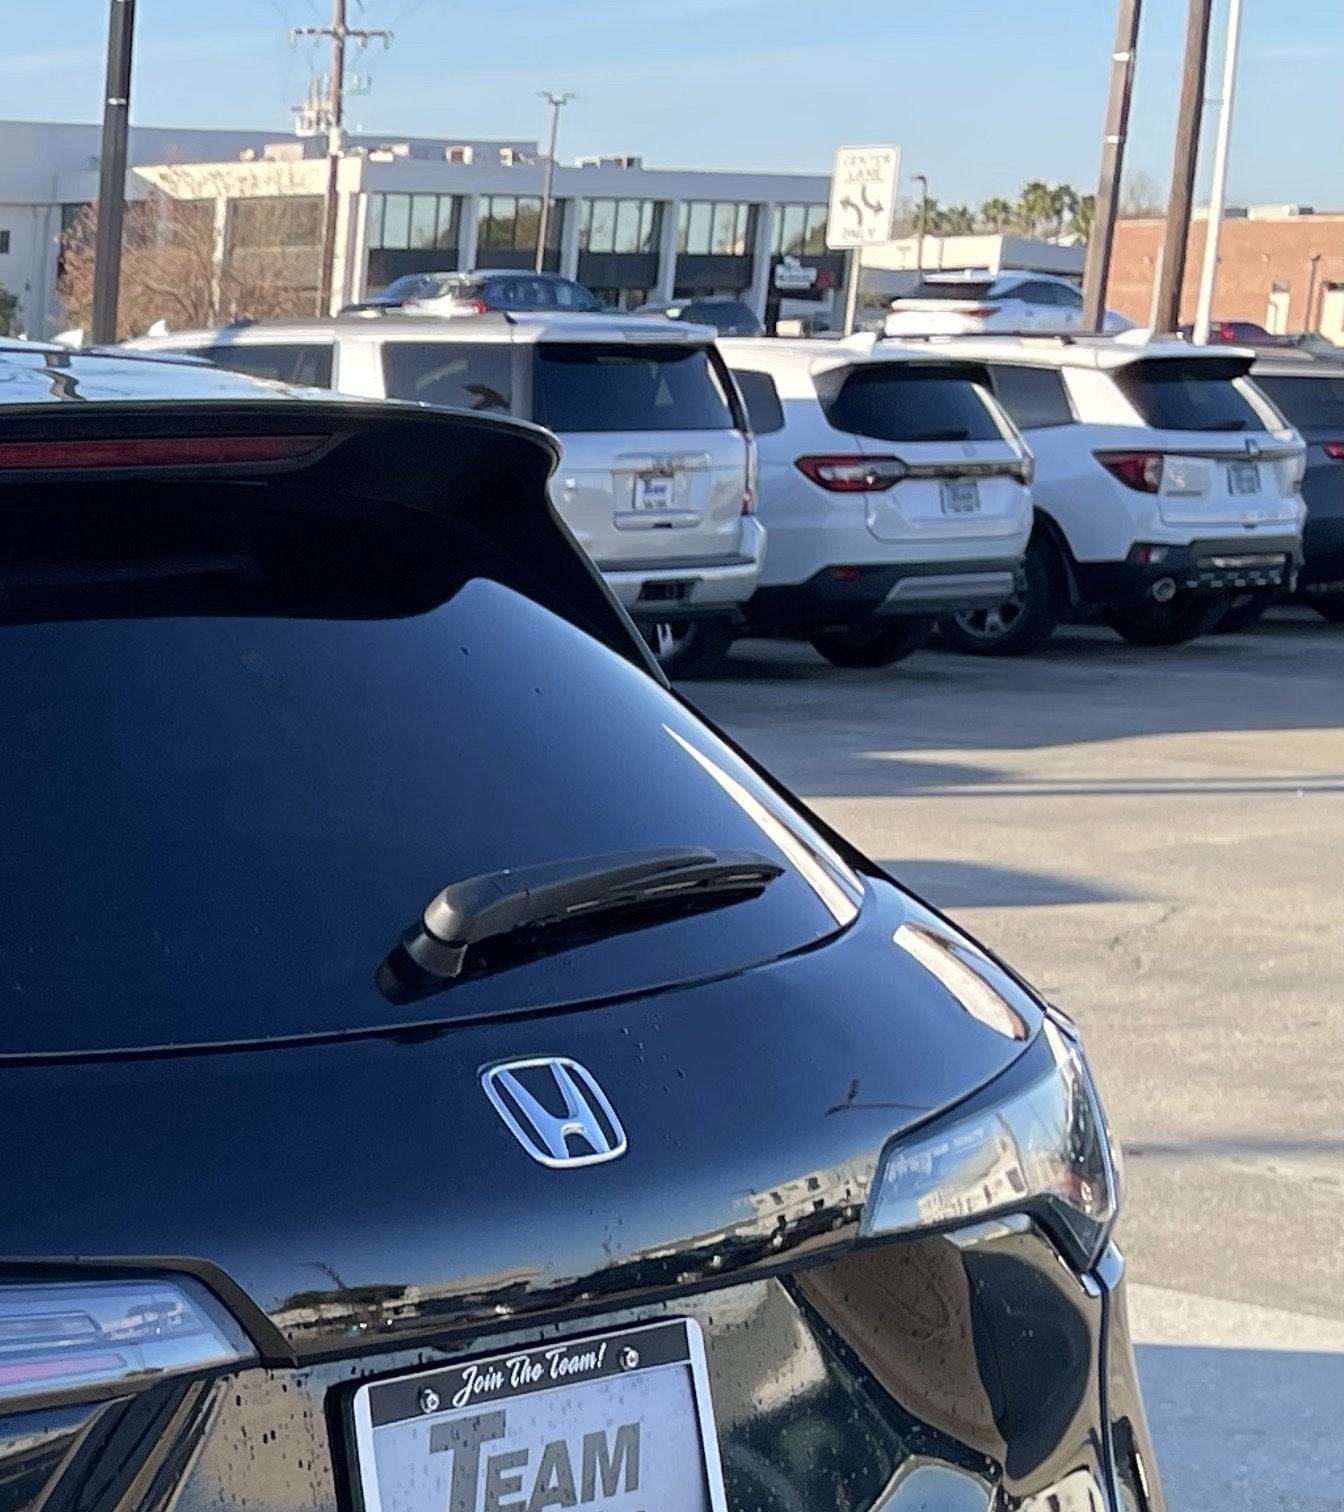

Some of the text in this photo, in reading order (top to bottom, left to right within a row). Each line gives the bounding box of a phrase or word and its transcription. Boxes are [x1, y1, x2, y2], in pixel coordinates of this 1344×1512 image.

[452, 1342, 607, 1408] Join The Team!
